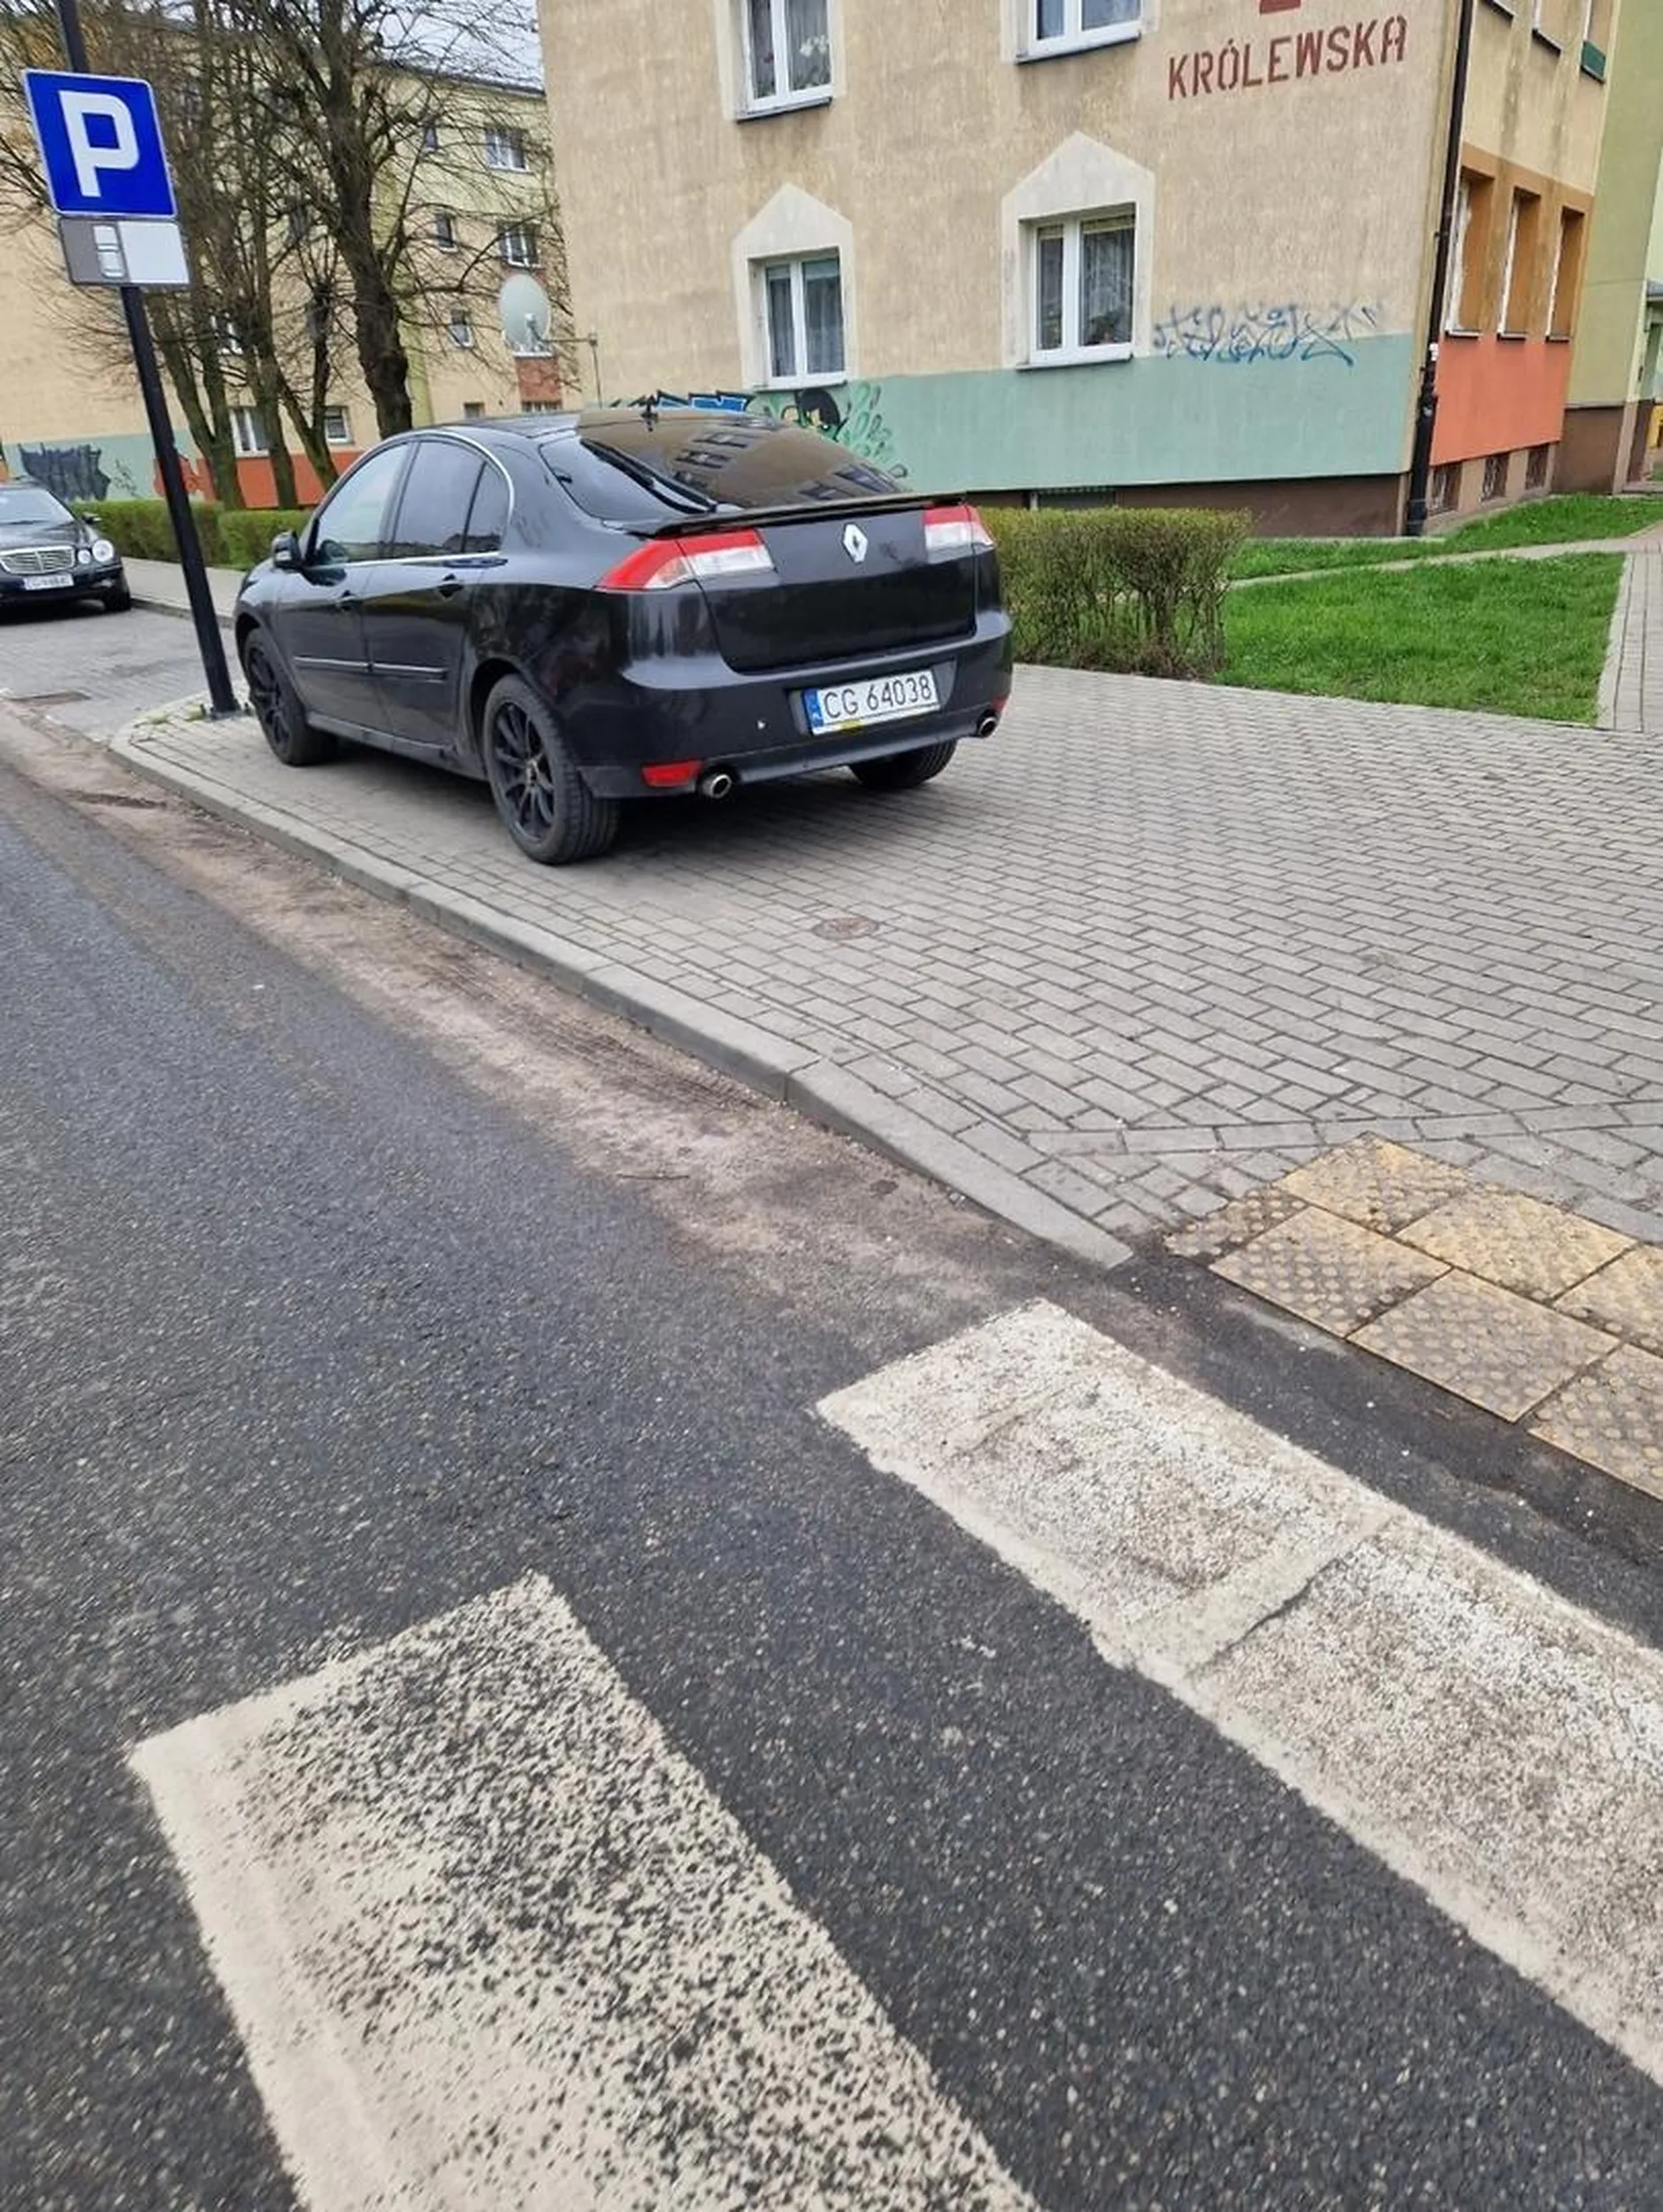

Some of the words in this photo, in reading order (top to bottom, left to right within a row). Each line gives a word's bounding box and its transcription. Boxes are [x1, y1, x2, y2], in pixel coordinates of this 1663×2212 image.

[1169, 15, 1407, 100] KRÓLEWSKA
[58, 90, 140, 197] P
[824, 688, 858, 718] CG
[867, 675, 931, 710] 64038
